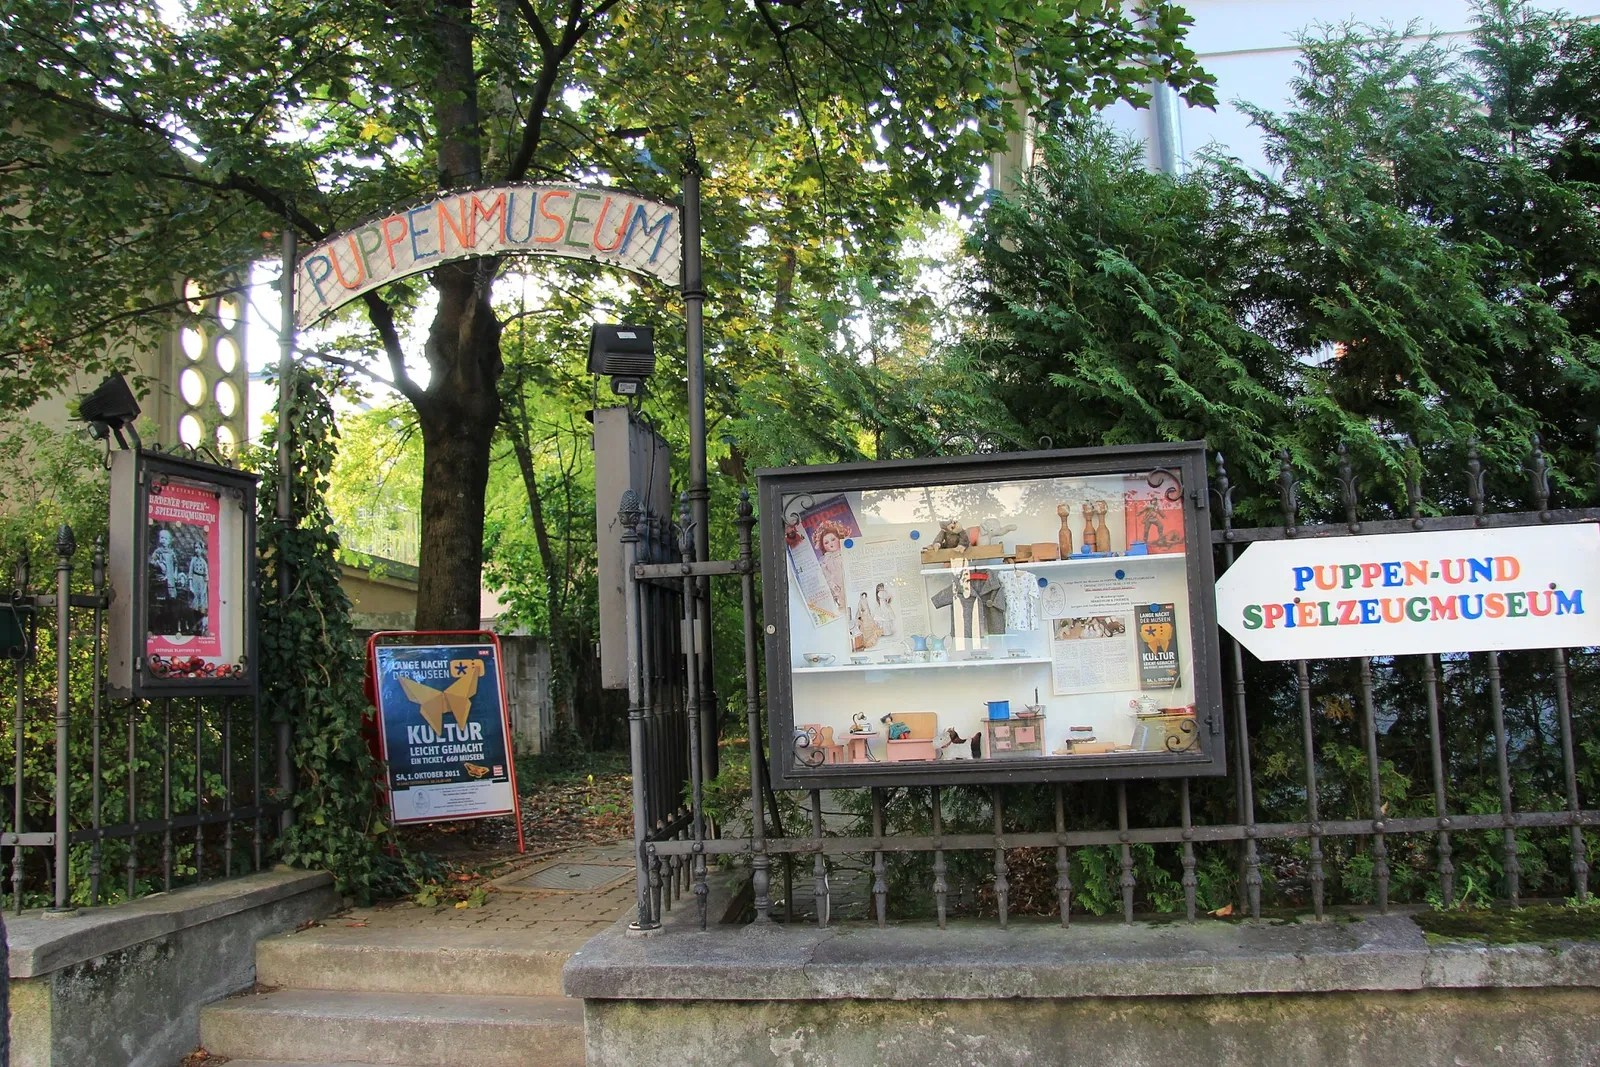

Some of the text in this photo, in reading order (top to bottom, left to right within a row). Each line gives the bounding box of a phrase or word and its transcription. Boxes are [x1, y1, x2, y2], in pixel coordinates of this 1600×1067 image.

[304, 190, 673, 305] PUPPENMUSEUM
[1242, 589, 1585, 630] SPIELZEUGMUSEUM
[1142, 651, 1175, 661] KULTUR
[393, 660, 448, 670] LANGE NACHT
[393, 669, 450, 680] DER MUSEEN
[407, 722, 483, 745] KULTUR
[410, 743, 484, 757] LEICHT GEMACHT
[411, 757, 421, 765] EIN
[422, 756, 446, 764] TICKET,
[459, 753, 485, 761] MUSEEN
[414, 771, 444, 780] OKTOBER
[445, 770, 460, 778] 2011
